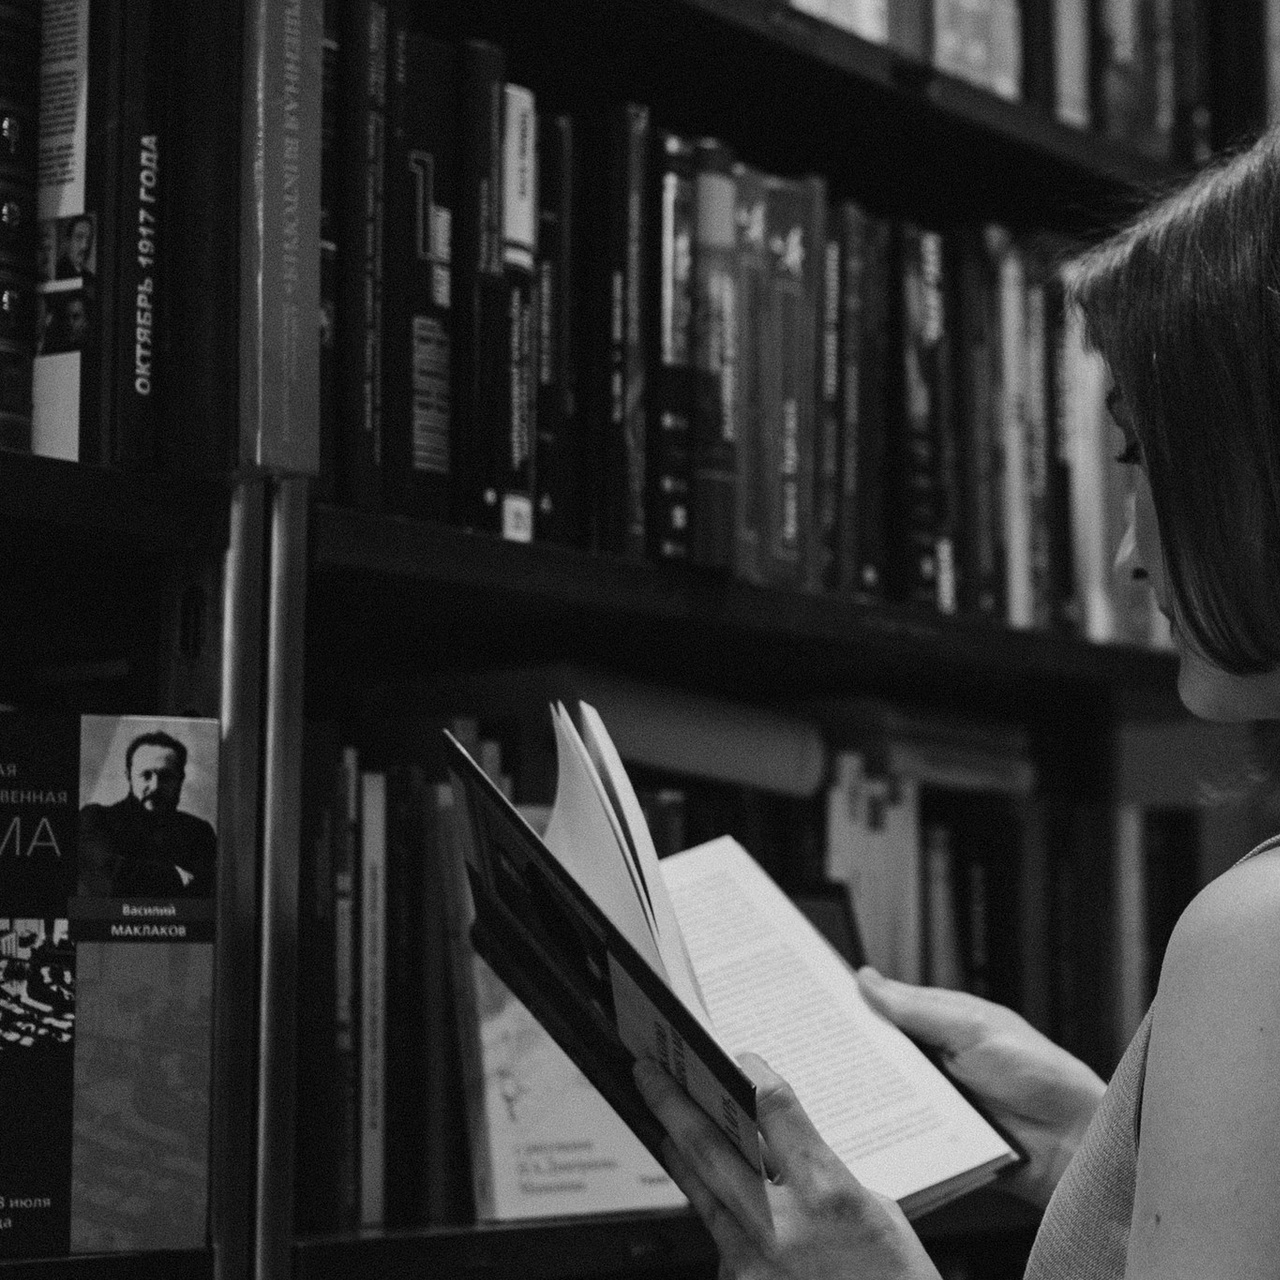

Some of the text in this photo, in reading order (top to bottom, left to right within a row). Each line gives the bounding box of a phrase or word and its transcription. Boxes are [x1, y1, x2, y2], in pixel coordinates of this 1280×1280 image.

[134, 134, 159, 397] ОКТЯБРЬ 1917 ГОДА
[122, 903, 177, 917] Василий
[110, 923, 187, 938] МАКЛАКОВ
[9, 1197, 52, 1209] июля
